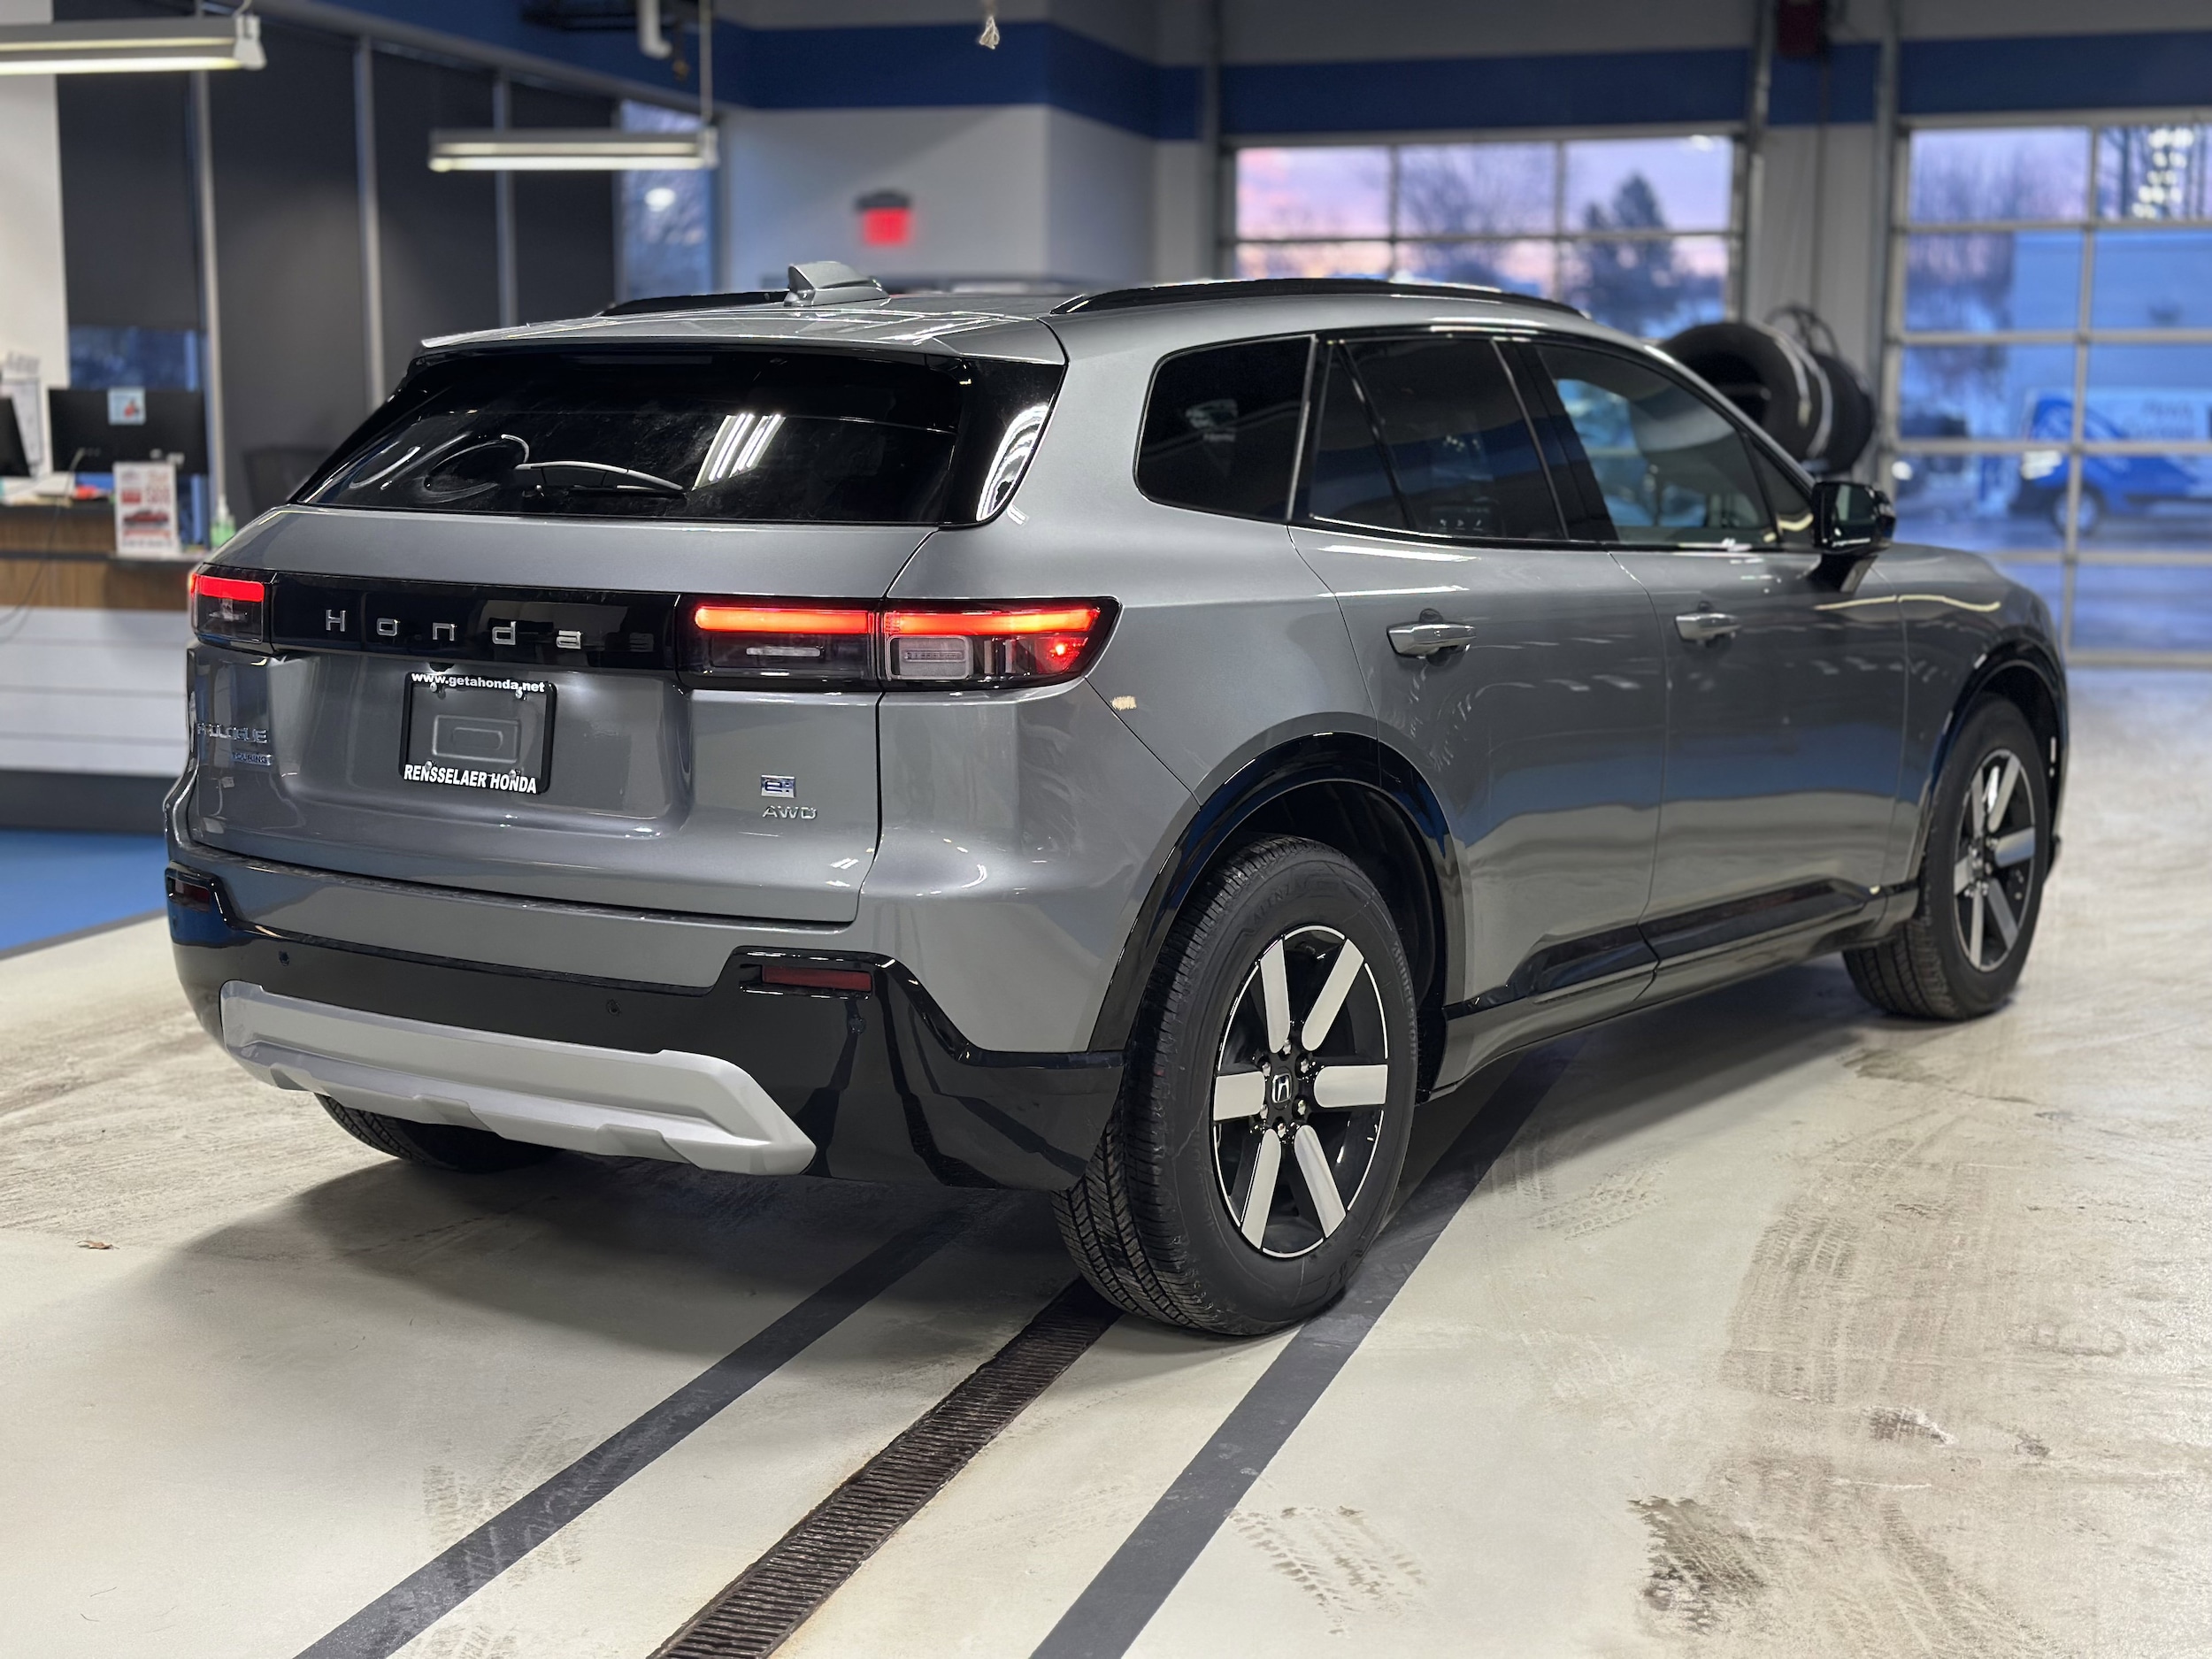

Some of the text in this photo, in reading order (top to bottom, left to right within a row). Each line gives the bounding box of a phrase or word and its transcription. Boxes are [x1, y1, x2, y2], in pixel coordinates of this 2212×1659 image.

[325, 608, 584, 650] Honda
[411, 672, 546, 694] www.getahonda.net
[403, 764, 538, 795] RENSSELAER HONDA
[761, 805, 818, 819] AWD
